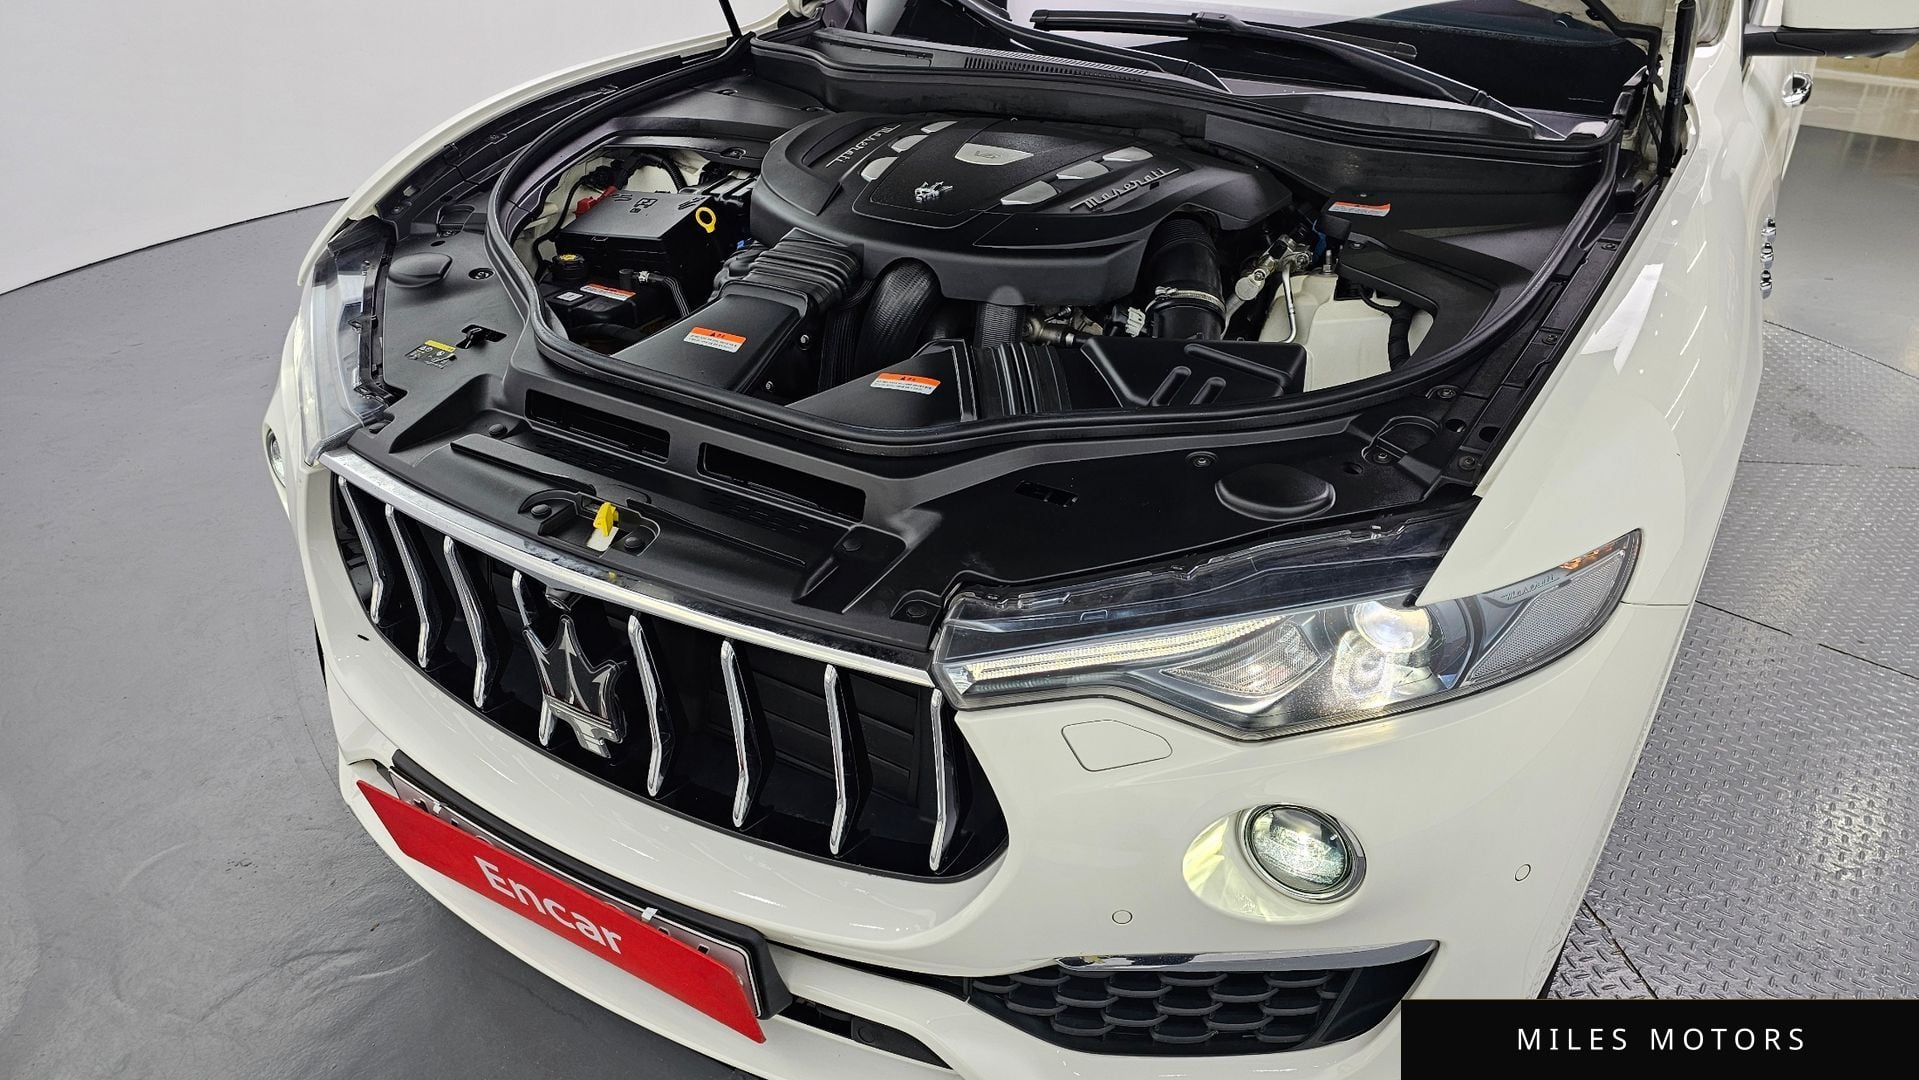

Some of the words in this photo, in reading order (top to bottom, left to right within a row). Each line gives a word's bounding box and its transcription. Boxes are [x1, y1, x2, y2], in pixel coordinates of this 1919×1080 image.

[825, 124, 901, 168] Maserati
[1070, 167, 1179, 210] Maserati
[473, 855, 622, 954] Encar
